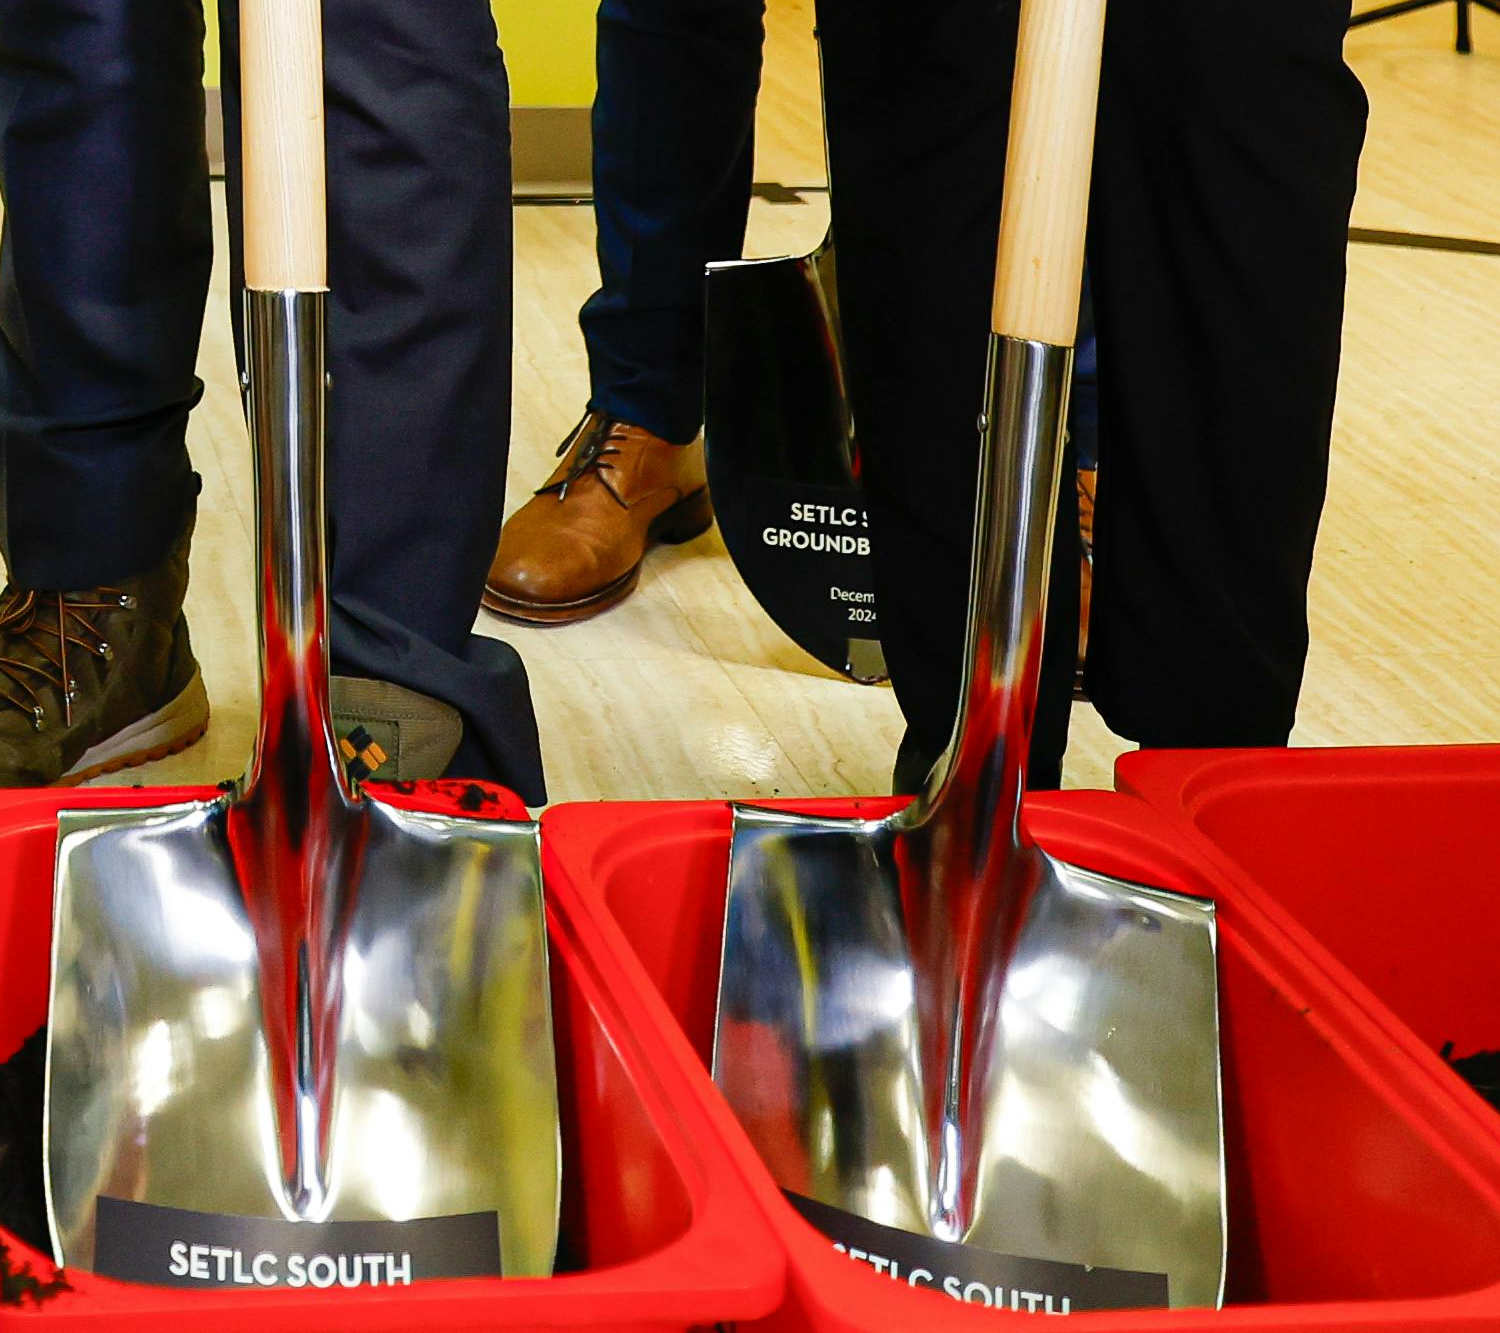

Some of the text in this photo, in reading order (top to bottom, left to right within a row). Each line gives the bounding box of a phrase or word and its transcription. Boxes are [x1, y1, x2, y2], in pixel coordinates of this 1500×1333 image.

[790, 502, 857, 527] SETLC
[762, 527, 871, 556] GROUNDB
[830, 586, 875, 604] Decem
[168, 1240, 412, 1288] SETLC SOUTH
